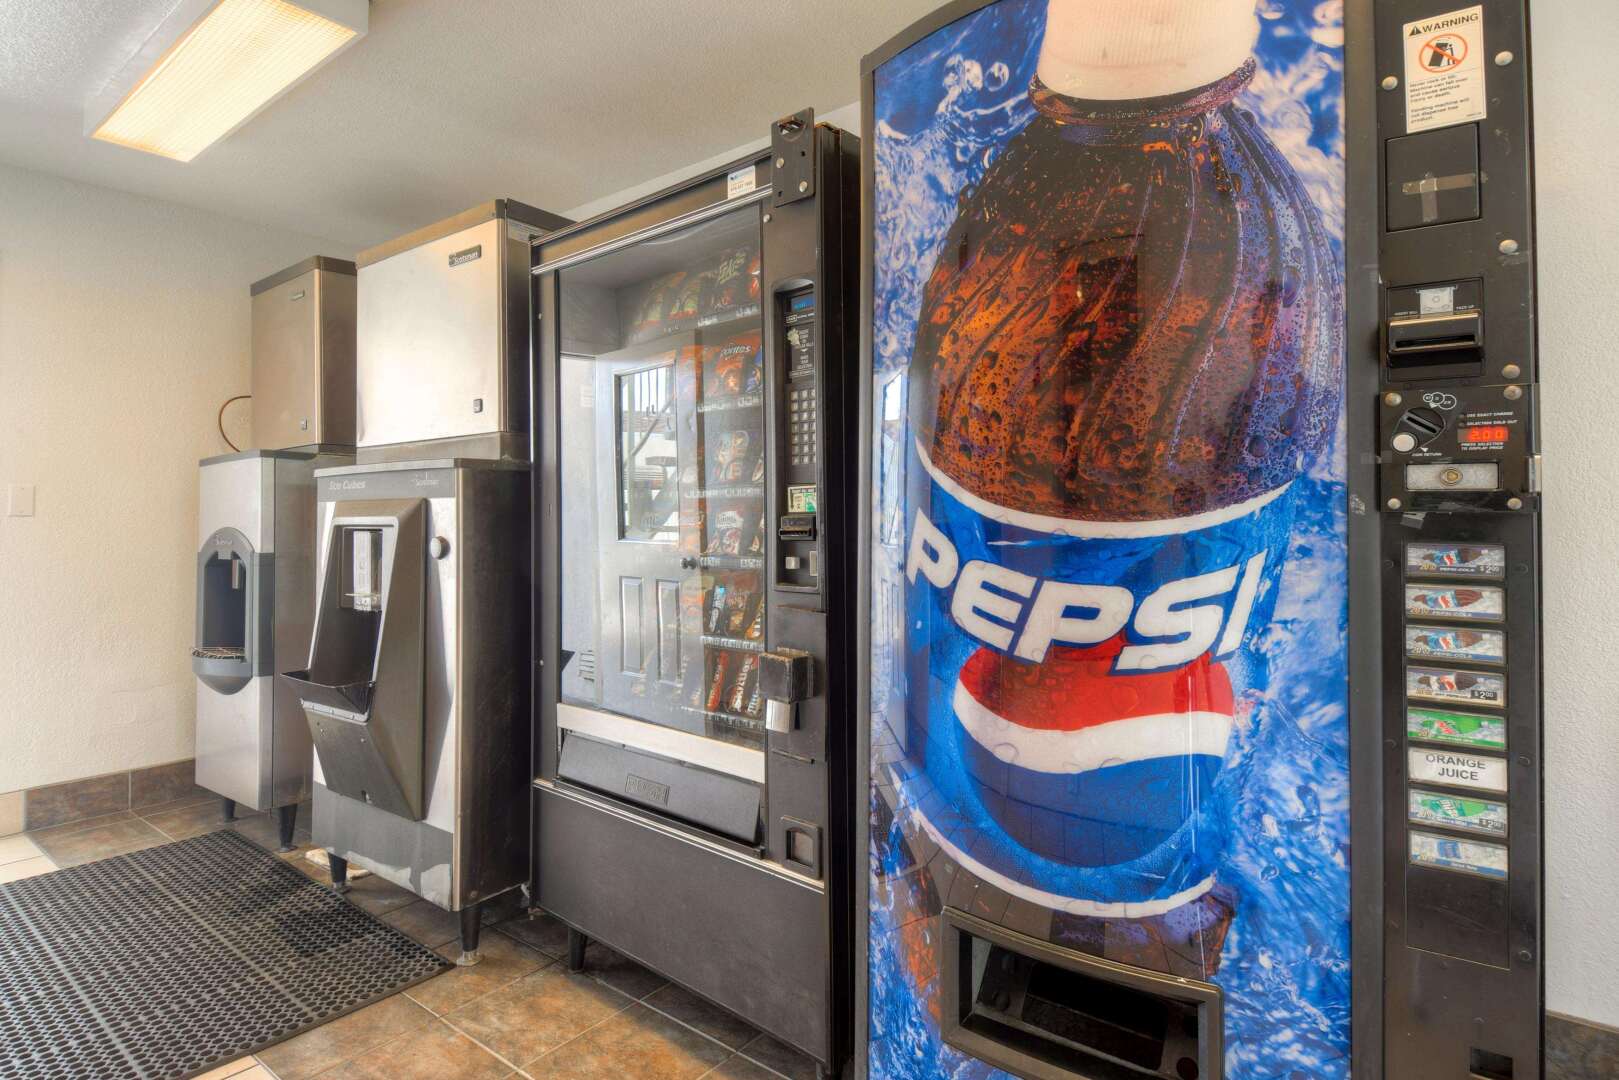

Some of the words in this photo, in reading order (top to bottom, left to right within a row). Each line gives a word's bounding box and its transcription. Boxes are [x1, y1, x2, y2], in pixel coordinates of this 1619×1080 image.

[1423, 13, 1479, 33] WARNING
[906, 507, 1268, 671] PEPSI
[1426, 753, 1486, 769] ORANGE
[1437, 767, 1480, 781] JUICE
